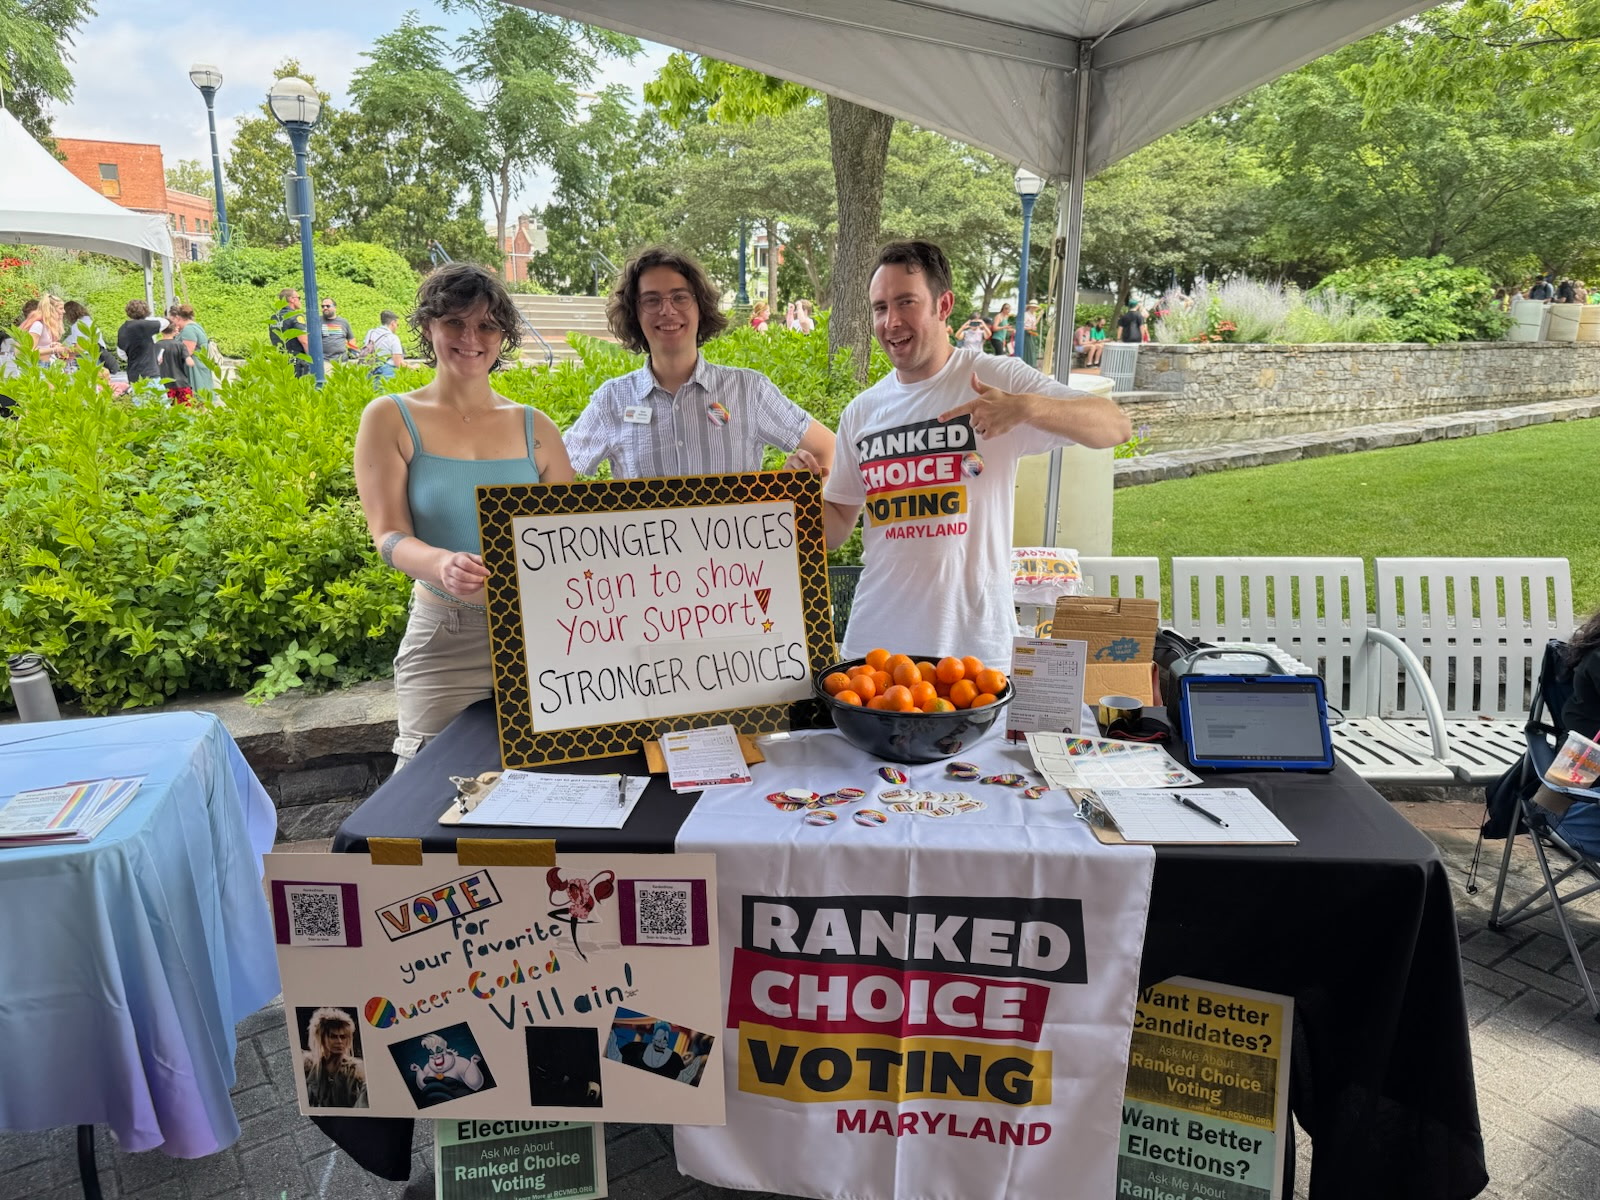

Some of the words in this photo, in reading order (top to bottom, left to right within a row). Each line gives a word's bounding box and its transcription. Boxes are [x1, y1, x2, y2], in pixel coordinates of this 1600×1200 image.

[860, 424, 969, 464] RANKED
[521, 518, 682, 571] STRONGER
[691, 512, 794, 551] VOICES
[885, 522, 968, 540] MARYLAND
[566, 569, 636, 614] sign
[650, 563, 681, 596] to
[696, 558, 764, 598] show
[557, 614, 628, 656] your
[538, 657, 691, 714] STRONGER
[696, 642, 806, 691] CHOICES
[382, 876, 492, 933] VOTE
[452, 916, 490, 939] for
[752, 901, 1071, 972] RANKED
[400, 951, 452, 984] your
[462, 922, 562, 968] favorite
[488, 962, 639, 1030] Villain!
[750, 969, 1028, 1033] CHOICE
[1197, 996, 1270, 1027] Better
[1133, 1009, 1273, 1054] Candidates?
[747, 1038, 1035, 1105] VOTING
[1131, 1052, 1197, 1079] Ranked
[1200, 1066, 1262, 1092] Choice
[1159, 1044, 1180, 1058] Ask
[1181, 1049, 1200, 1062] Me
[1201, 1053, 1235, 1070] About
[1166, 1076, 1223, 1105] Voting
[836, 1108, 1053, 1147] MARYLAND
[1122, 1105, 1180, 1137] Want
[1187, 1119, 1263, 1155] Better
[455, 1159, 519, 1181] Ranked
[523, 1152, 581, 1171] Choice
[480, 1149, 500, 1160] Ask
[503, 1145, 520, 1157] Me
[522, 1140, 554, 1153] About
[1127, 1134, 1250, 1181] Elections?
[491, 1173, 546, 1193] Voting
[553, 1185, 593, 1198] RCVMD.ORG
[1147, 1171, 1168, 1186] Ask
[1171, 1176, 1190, 1191] Me
[1192, 1182, 1227, 1200] About
